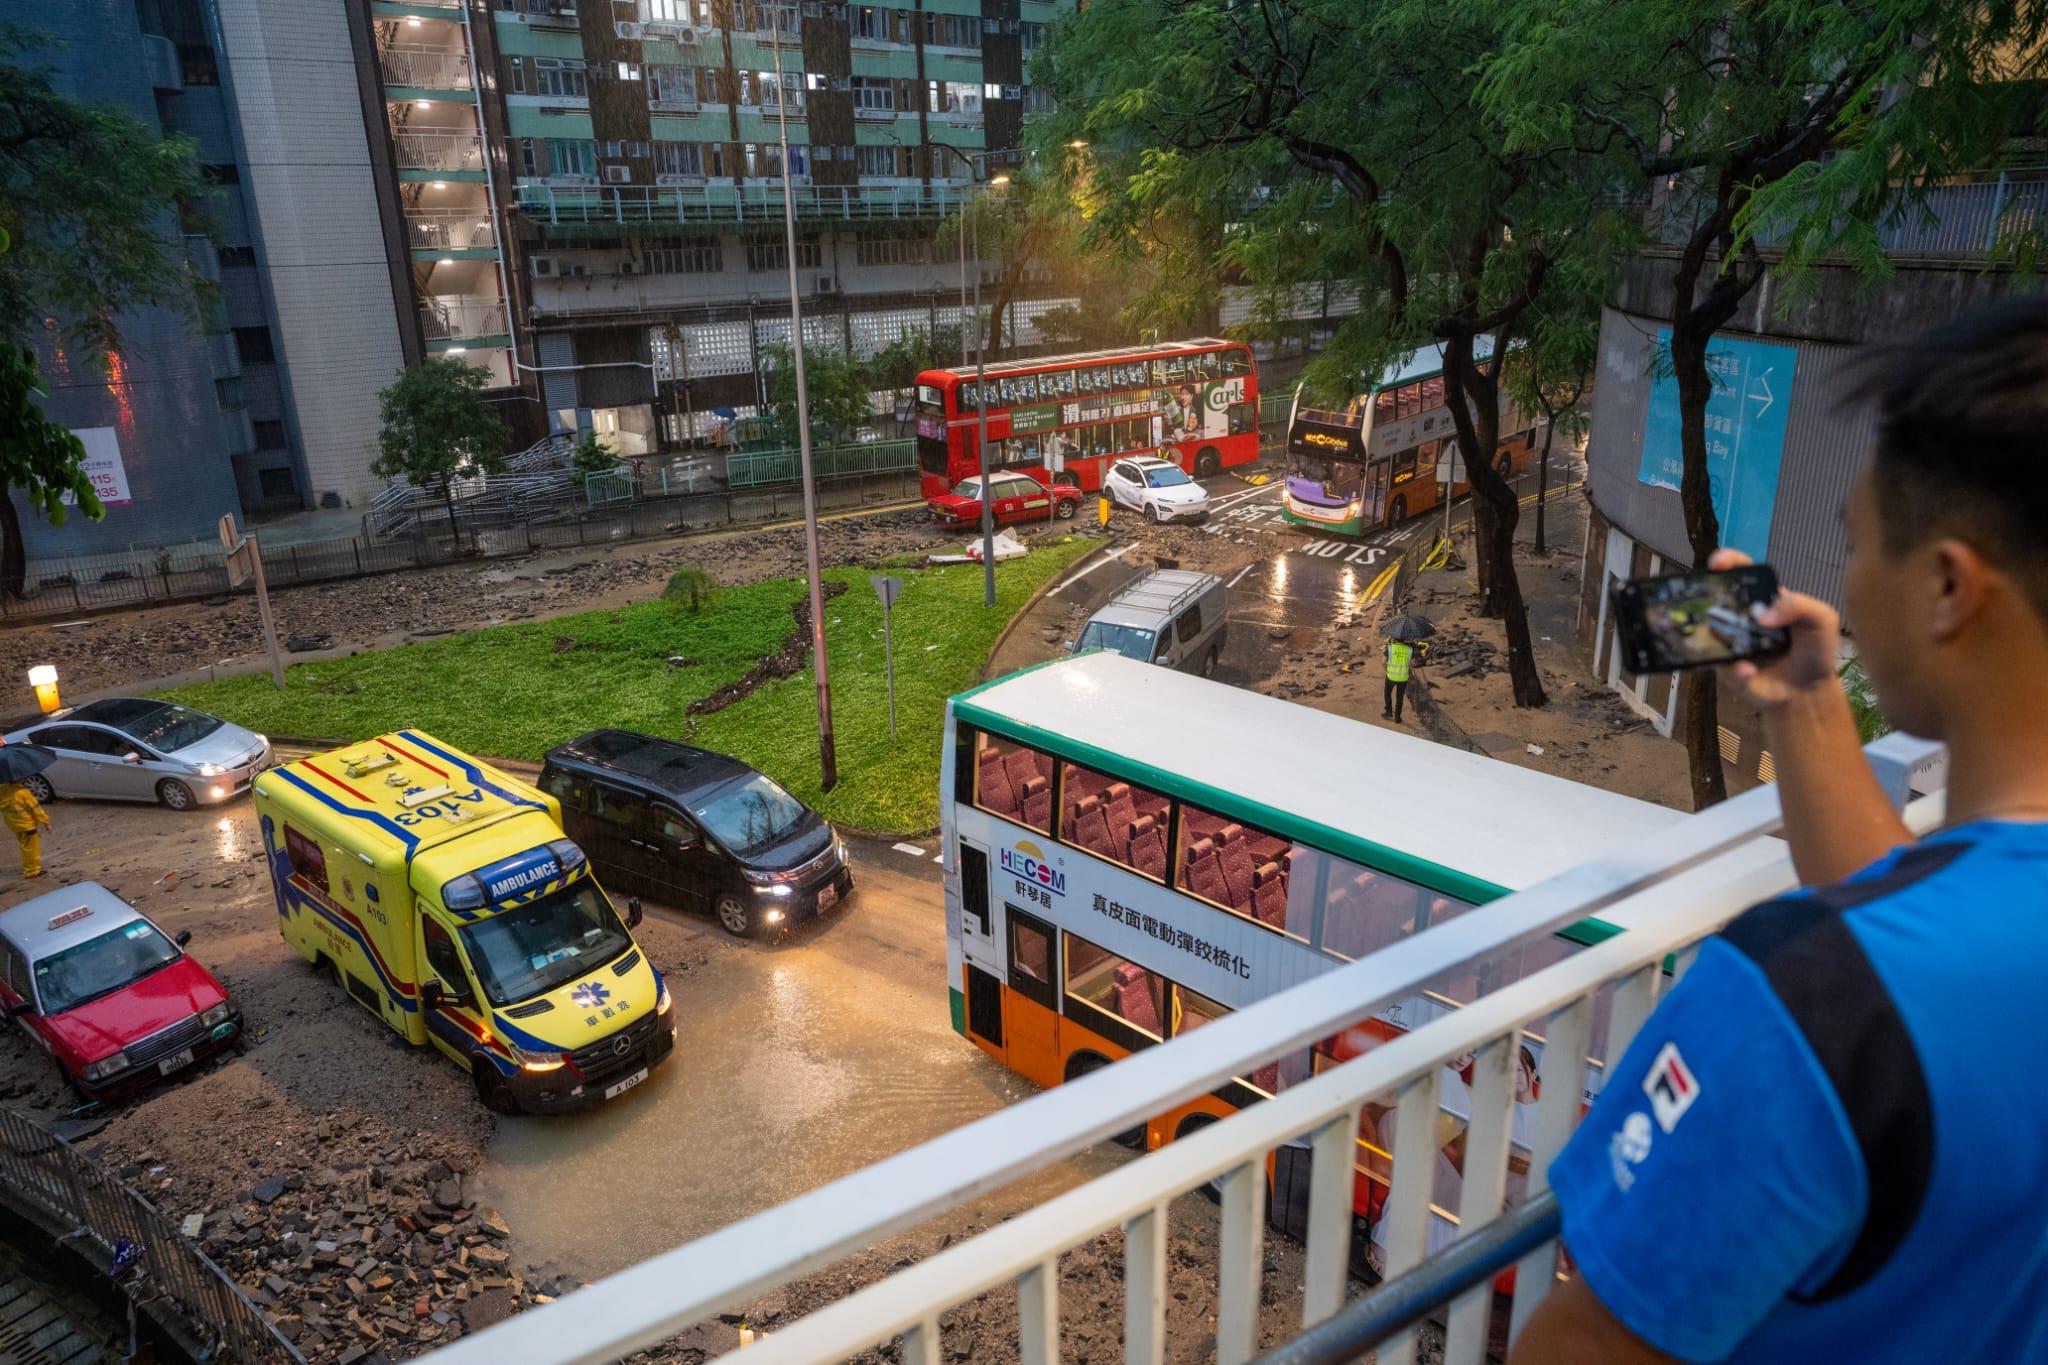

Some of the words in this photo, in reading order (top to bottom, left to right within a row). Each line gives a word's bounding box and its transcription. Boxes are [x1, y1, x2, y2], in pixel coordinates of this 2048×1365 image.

[90, 473, 112, 484] 115
[96, 487, 118, 498] 135
[1301, 539, 1386, 565] SLOW
[394, 789, 484, 826] A103
[491, 860, 558, 898] AMBULANCE
[367, 903, 387, 926] A103
[1092, 892, 1251, 980] 真皮面電動彈鉸梳化
[616, 1084, 623, 1093] A
[624, 1074, 640, 1089] 103
